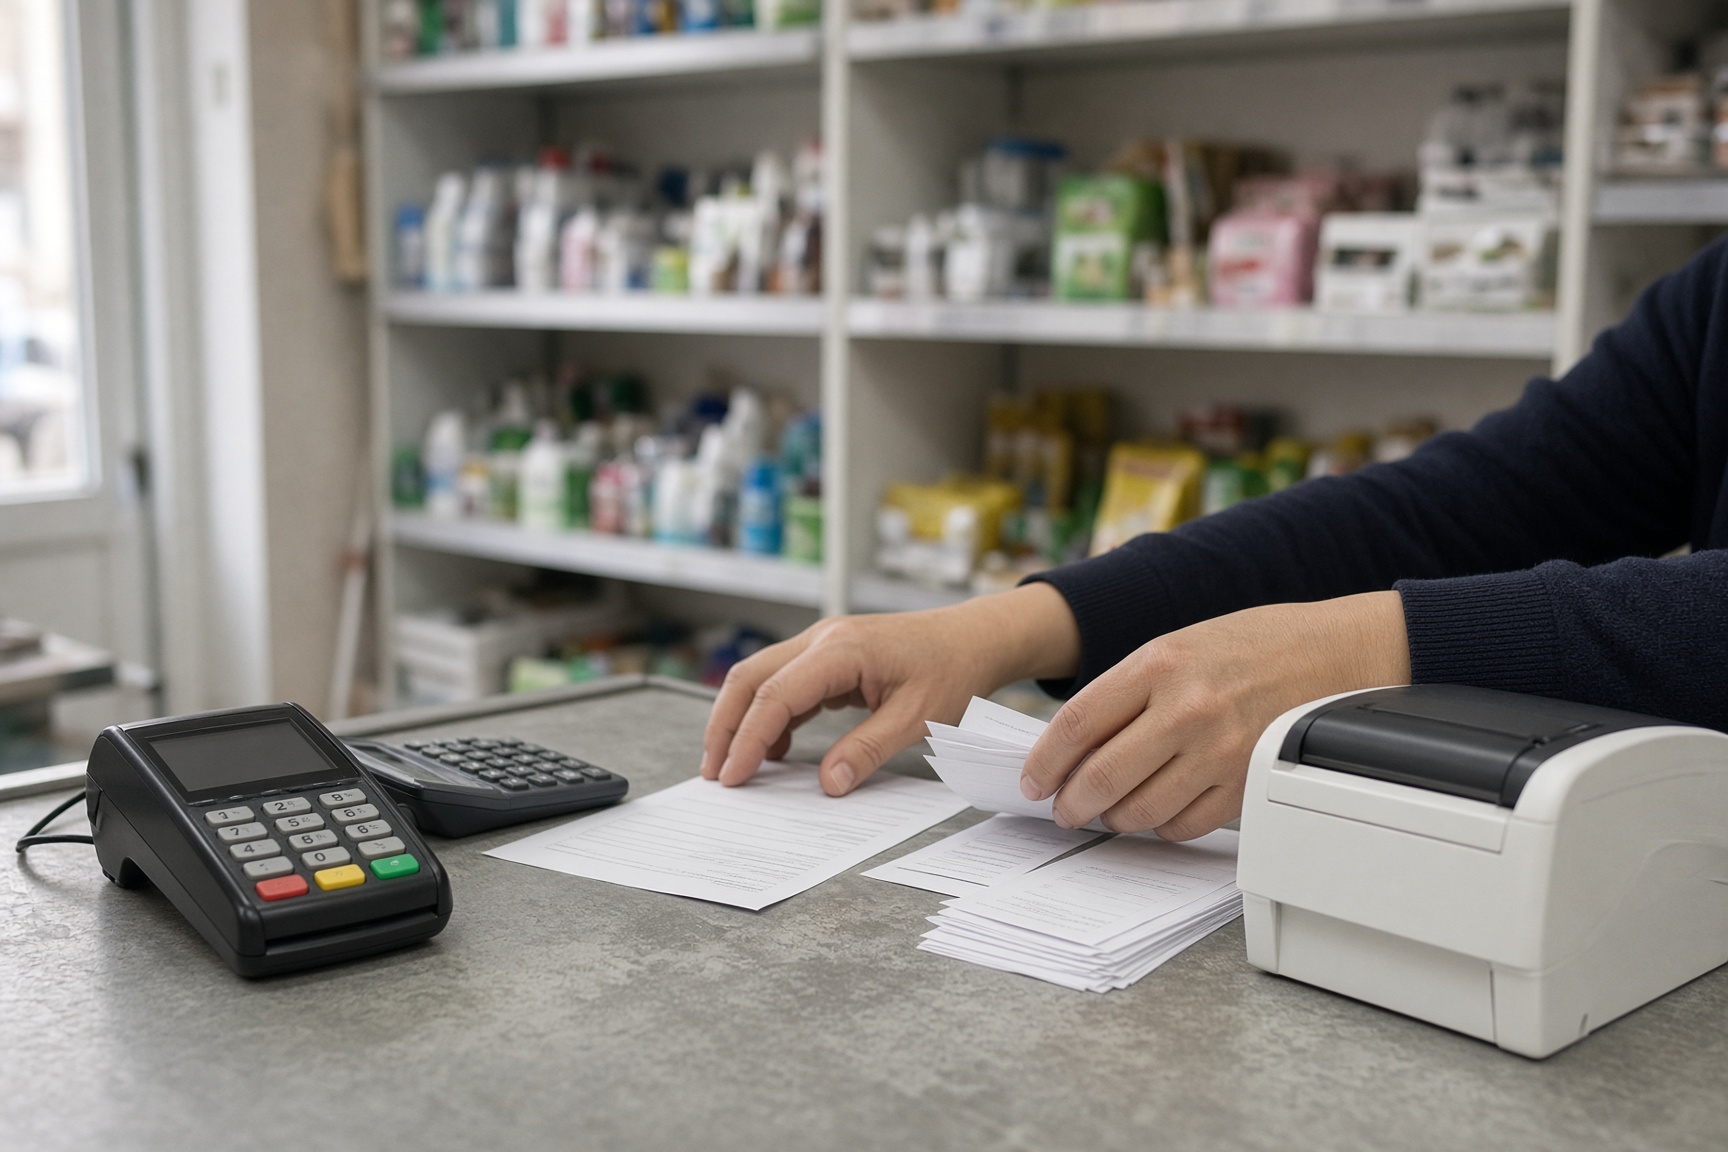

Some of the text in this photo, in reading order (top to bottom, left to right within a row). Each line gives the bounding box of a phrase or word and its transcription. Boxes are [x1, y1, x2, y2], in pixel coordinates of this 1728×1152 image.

[274, 802, 287, 811] 2
[288, 818, 300, 827] 5
[230, 827, 240, 836] 7
[244, 844, 255, 853] 4
[314, 852, 326, 862] 0
